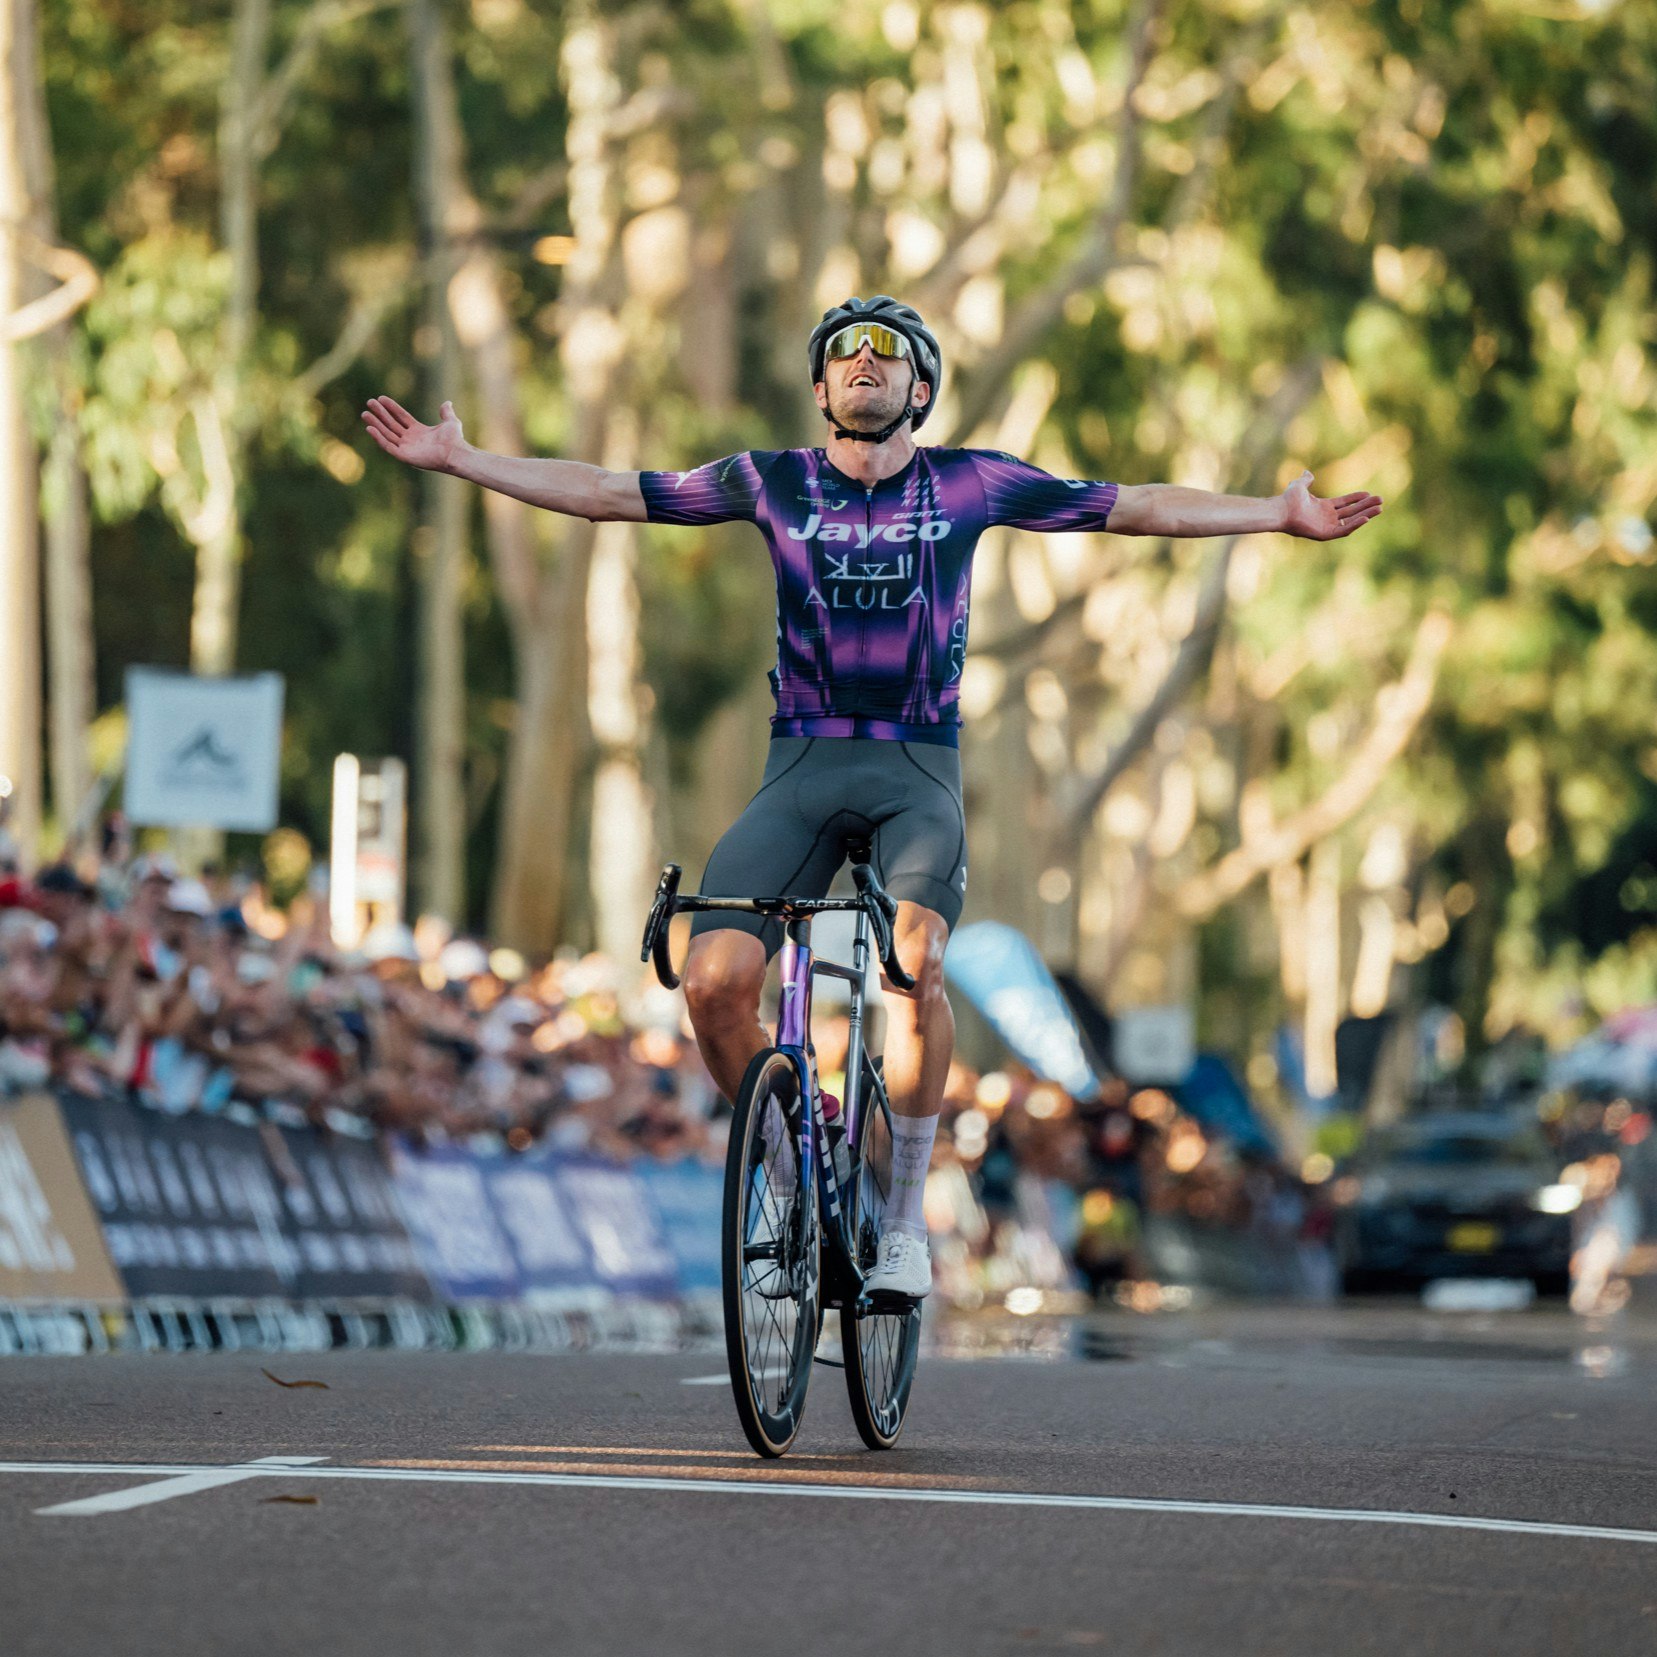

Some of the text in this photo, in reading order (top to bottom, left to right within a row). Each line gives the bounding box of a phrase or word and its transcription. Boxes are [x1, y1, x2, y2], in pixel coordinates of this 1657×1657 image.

[902, 475, 940, 487] MAAP
[901, 485, 941, 497] MAAP
[901, 495, 941, 507] MAAP
[892, 508, 948, 519] GIANT
[787, 514, 952, 549] Jayco
[803, 585, 929, 610] ALULA
[795, 900, 848, 908] CADEX
